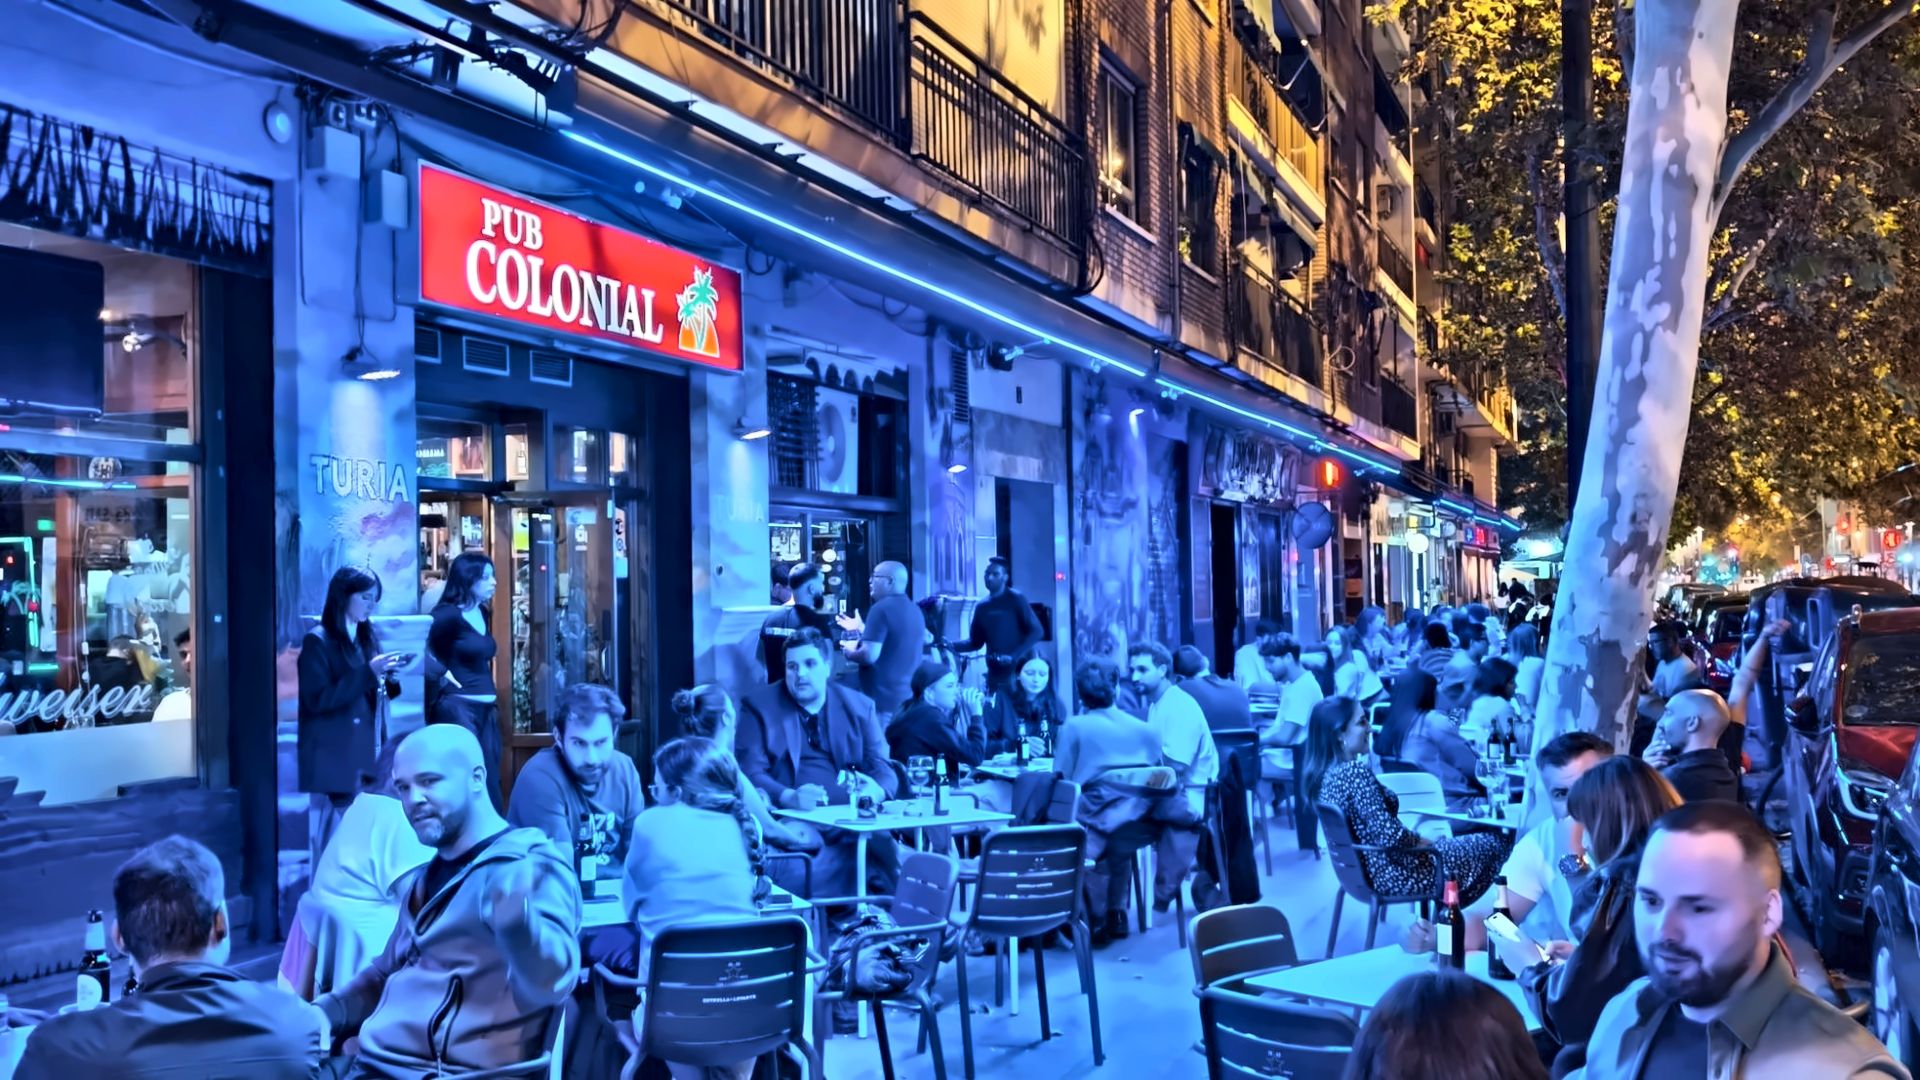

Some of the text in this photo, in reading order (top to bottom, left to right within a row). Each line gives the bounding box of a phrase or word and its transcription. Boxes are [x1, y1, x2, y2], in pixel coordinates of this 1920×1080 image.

[481, 198, 543, 250] PUB
[466, 240, 664, 343] COLONIAL
[310, 453, 410, 503] TURIA
[0, 682, 152, 723] weiser
